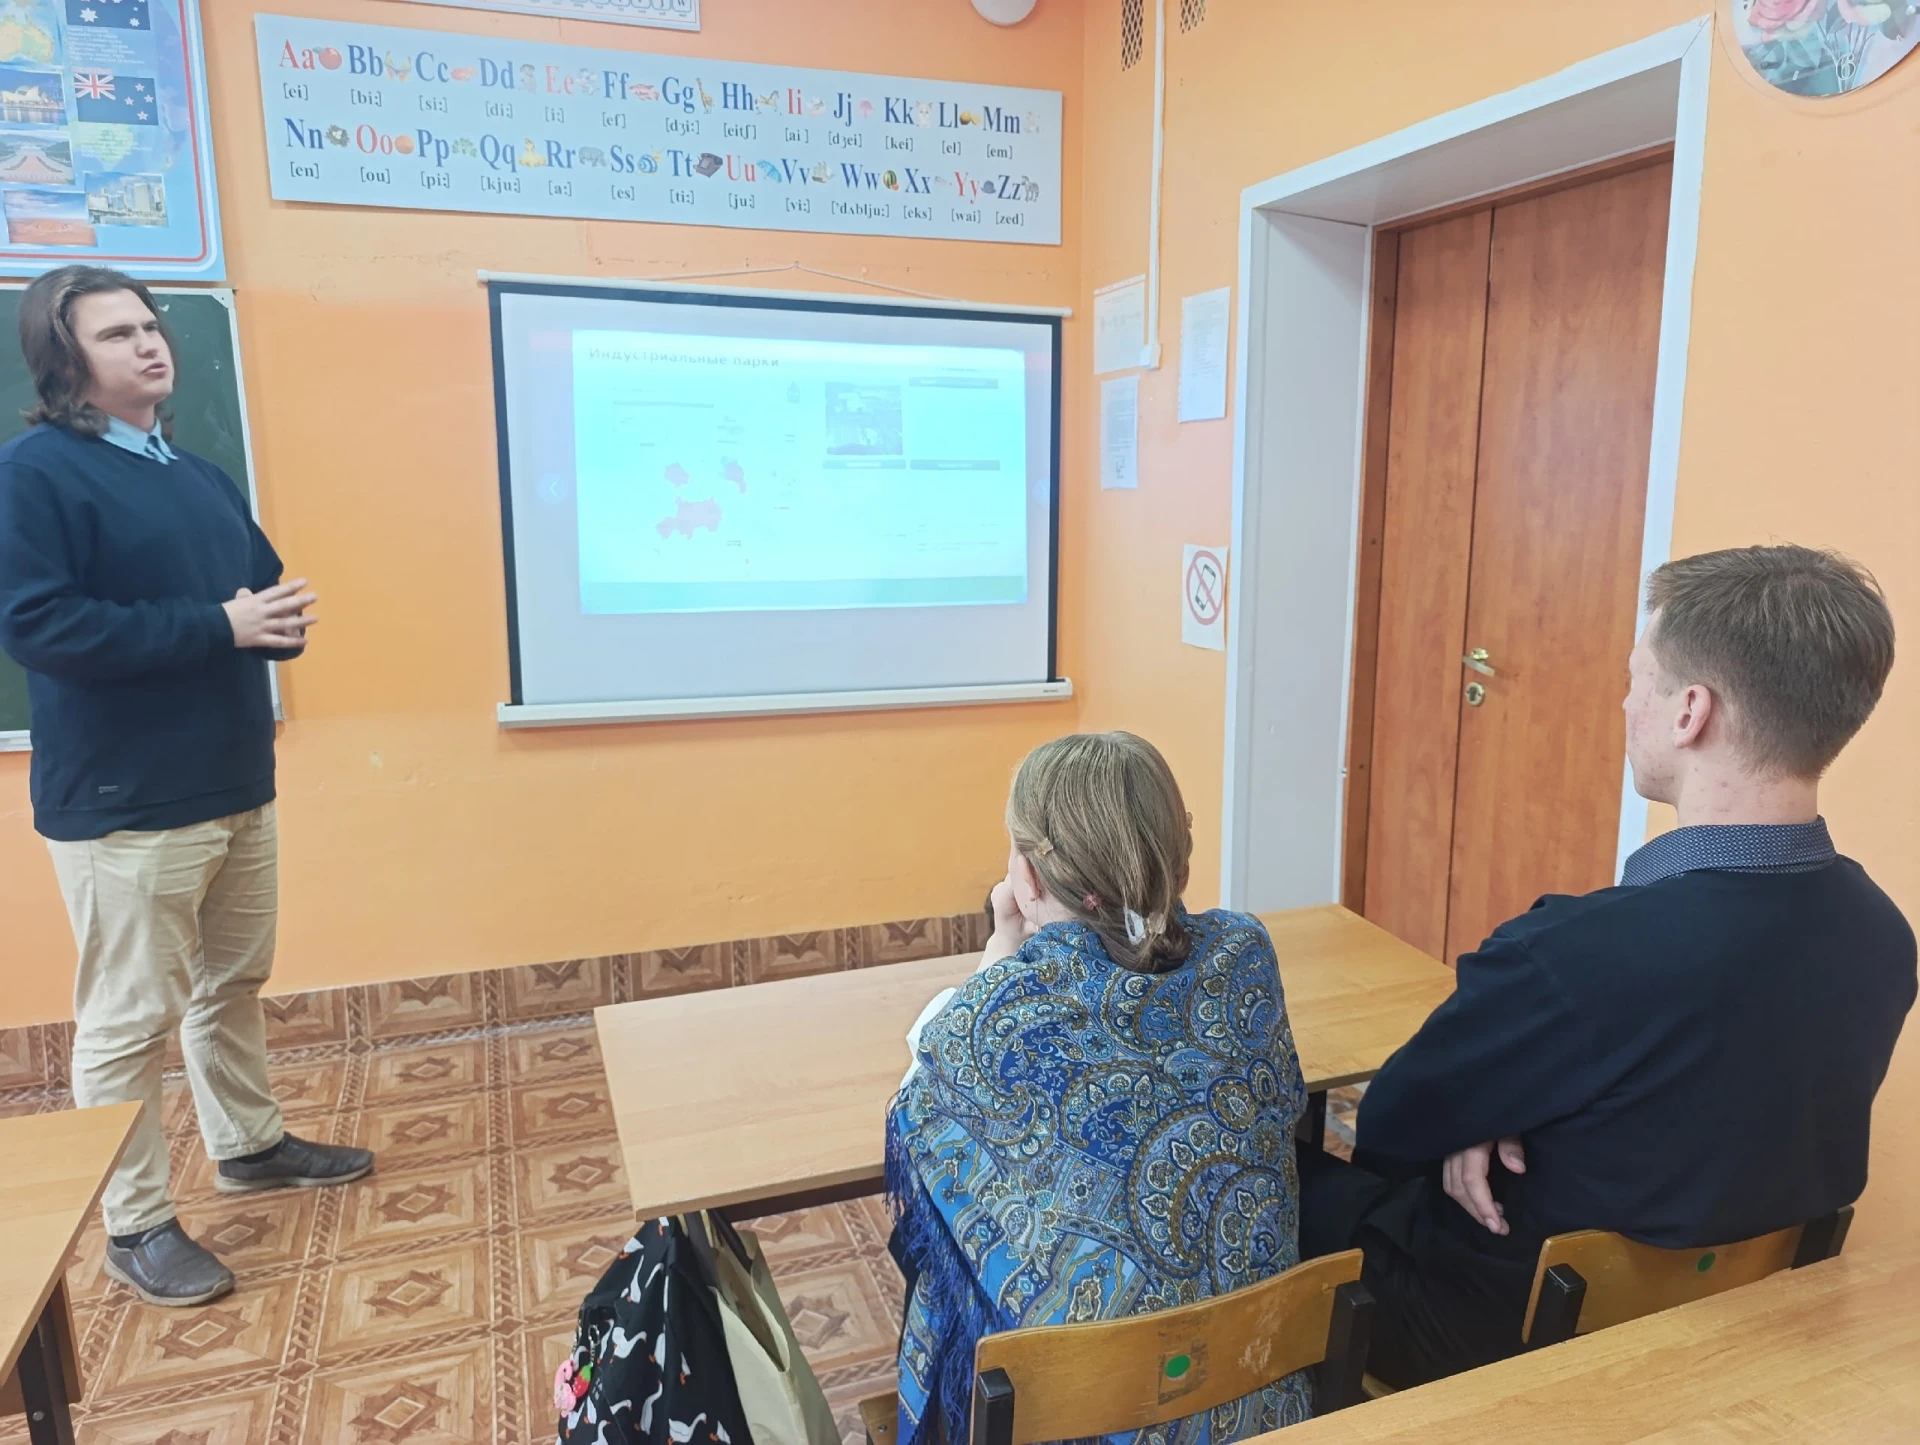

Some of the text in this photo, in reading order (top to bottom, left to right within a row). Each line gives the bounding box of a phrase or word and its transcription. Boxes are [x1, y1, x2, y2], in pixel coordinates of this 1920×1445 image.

[279, 39, 1020, 134] Aa Bb Cc Dd Ee Ff Gg Hh Ii Jj Kk Ll Mm
[1835, 52, 1856, 80] 6
[284, 118, 1021, 204] Nn Oo Pp Qq Rr Ss Tt Uu Vv Ww Xx Yy Zz
[590, 348, 779, 368] Индустриальные парки
